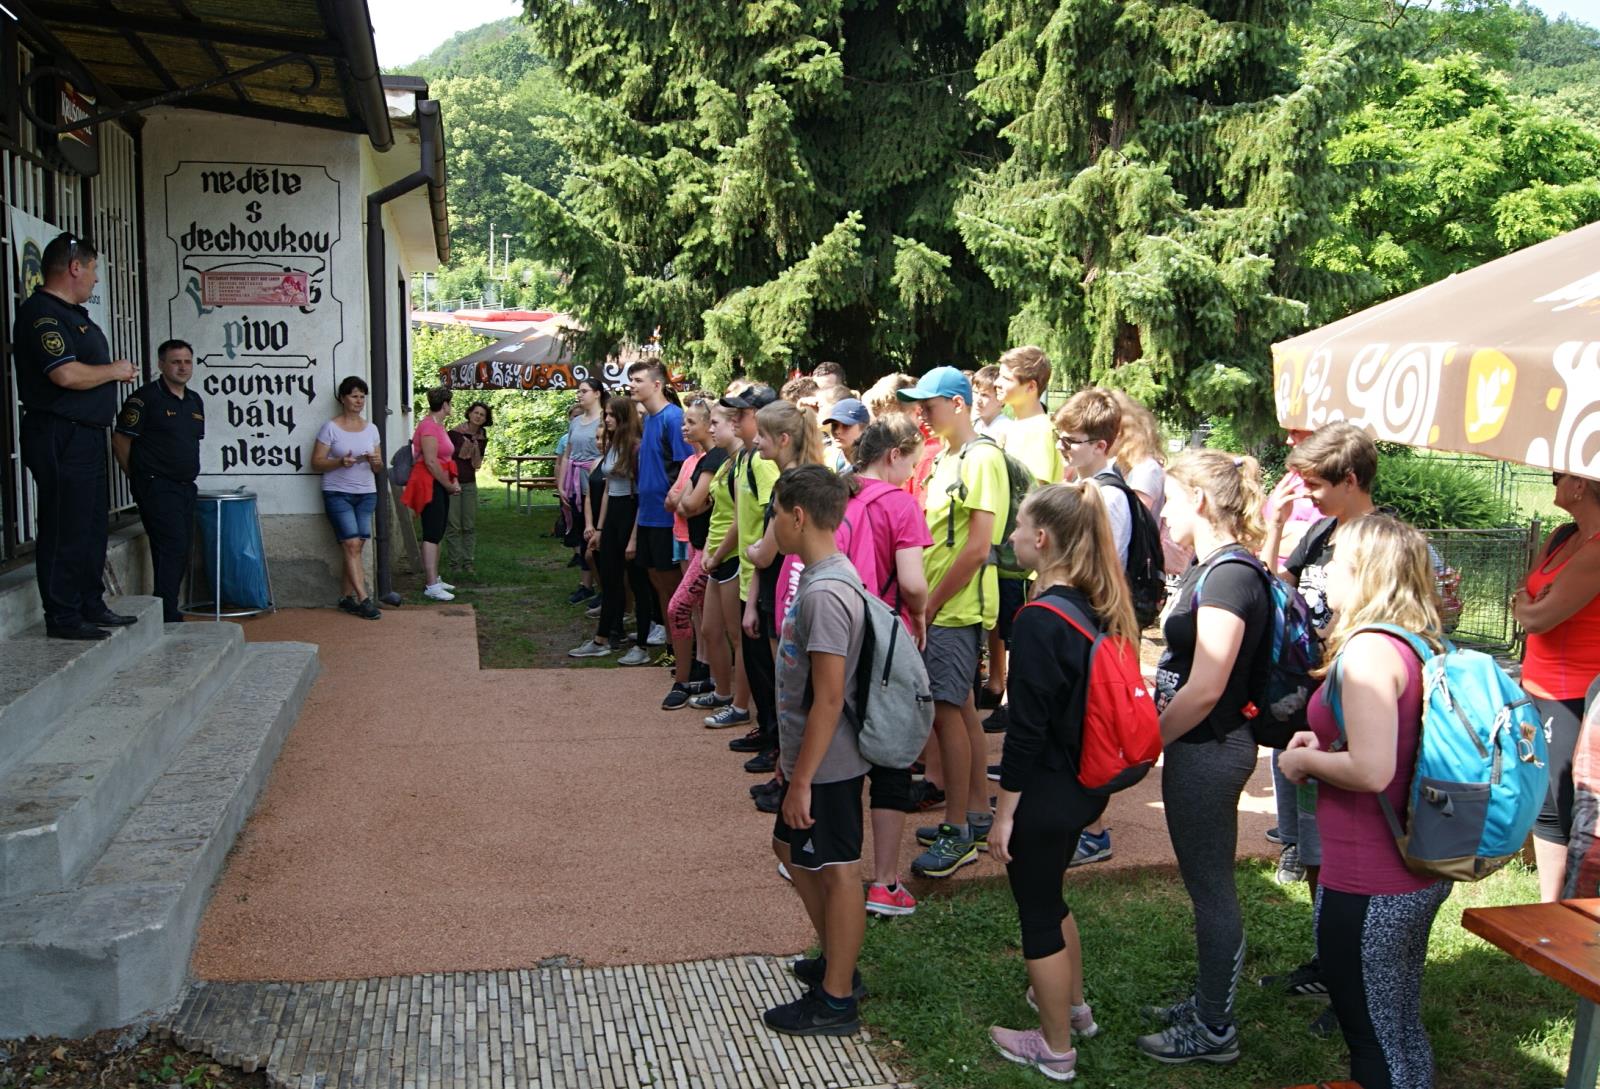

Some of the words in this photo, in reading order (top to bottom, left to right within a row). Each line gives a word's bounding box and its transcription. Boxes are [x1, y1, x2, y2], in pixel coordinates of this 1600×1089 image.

[201, 166, 302, 195] neděle
[180, 221, 330, 253] dechovkou
[222, 315, 288, 359] pivo
[203, 373, 316, 405] country
[227, 399, 297, 435] bály
[221, 438, 303, 472] plesy
